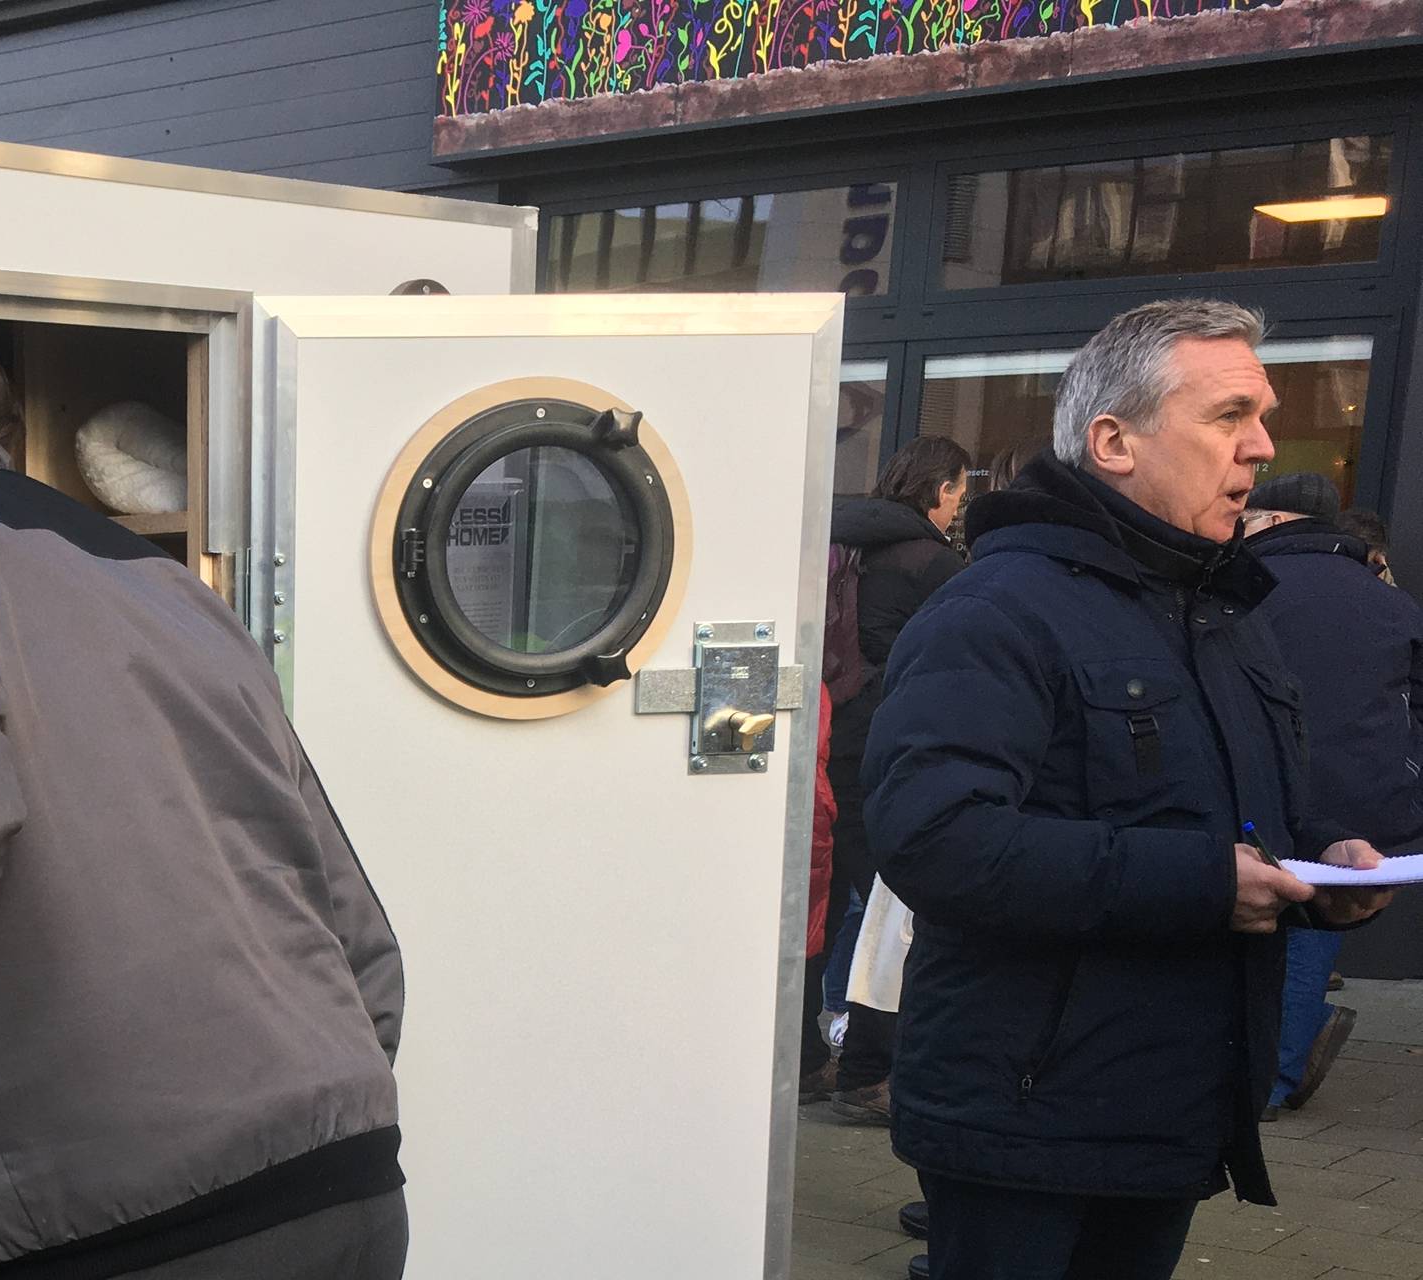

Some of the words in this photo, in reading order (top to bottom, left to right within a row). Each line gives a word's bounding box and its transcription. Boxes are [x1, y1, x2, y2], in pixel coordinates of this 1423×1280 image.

[966, 468, 989, 477] esetz
[452, 507, 502, 525] ESS
[448, 527, 500, 546] HOME
